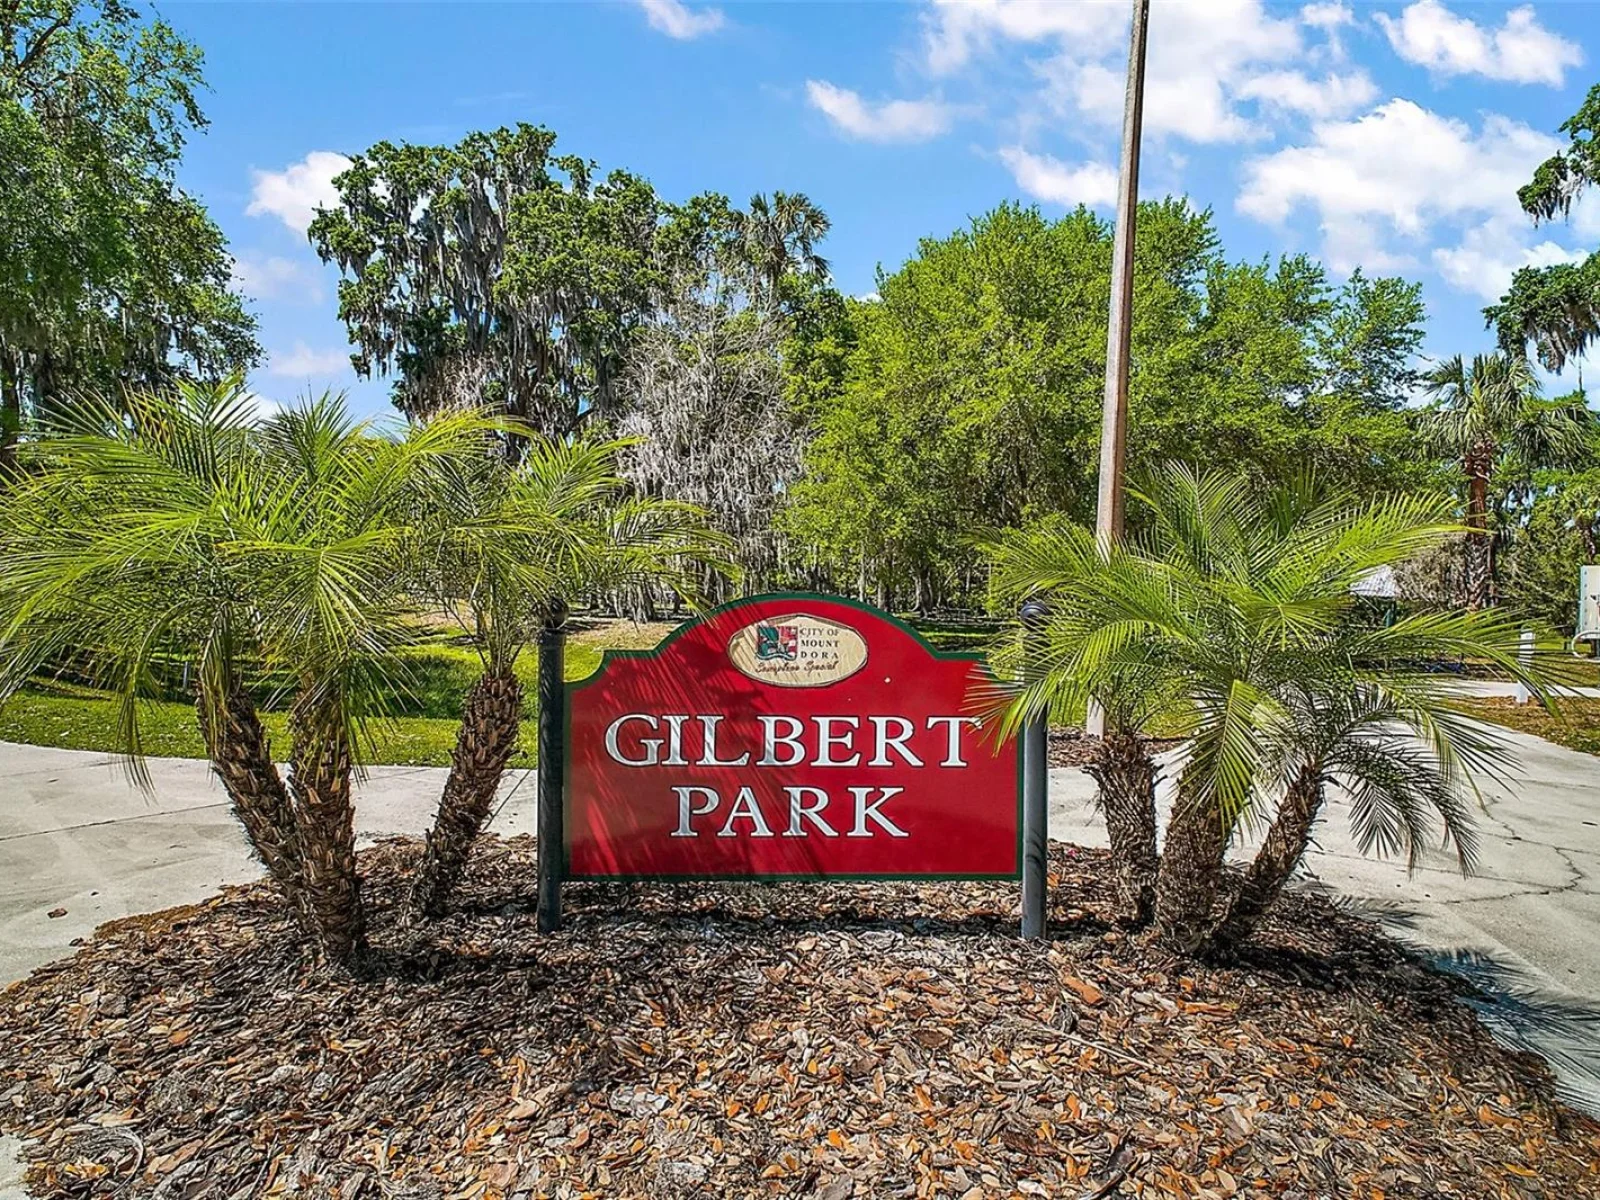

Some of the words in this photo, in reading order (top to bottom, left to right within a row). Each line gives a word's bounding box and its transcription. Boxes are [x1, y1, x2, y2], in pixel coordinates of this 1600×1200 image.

[800, 628, 824, 637] CITY
[827, 628, 839, 637] OF
[800, 639, 839, 648] MOUNT
[800, 651, 839, 659] DORA
[604, 713, 984, 768] GILBERT
[670, 785, 910, 838] PARK
